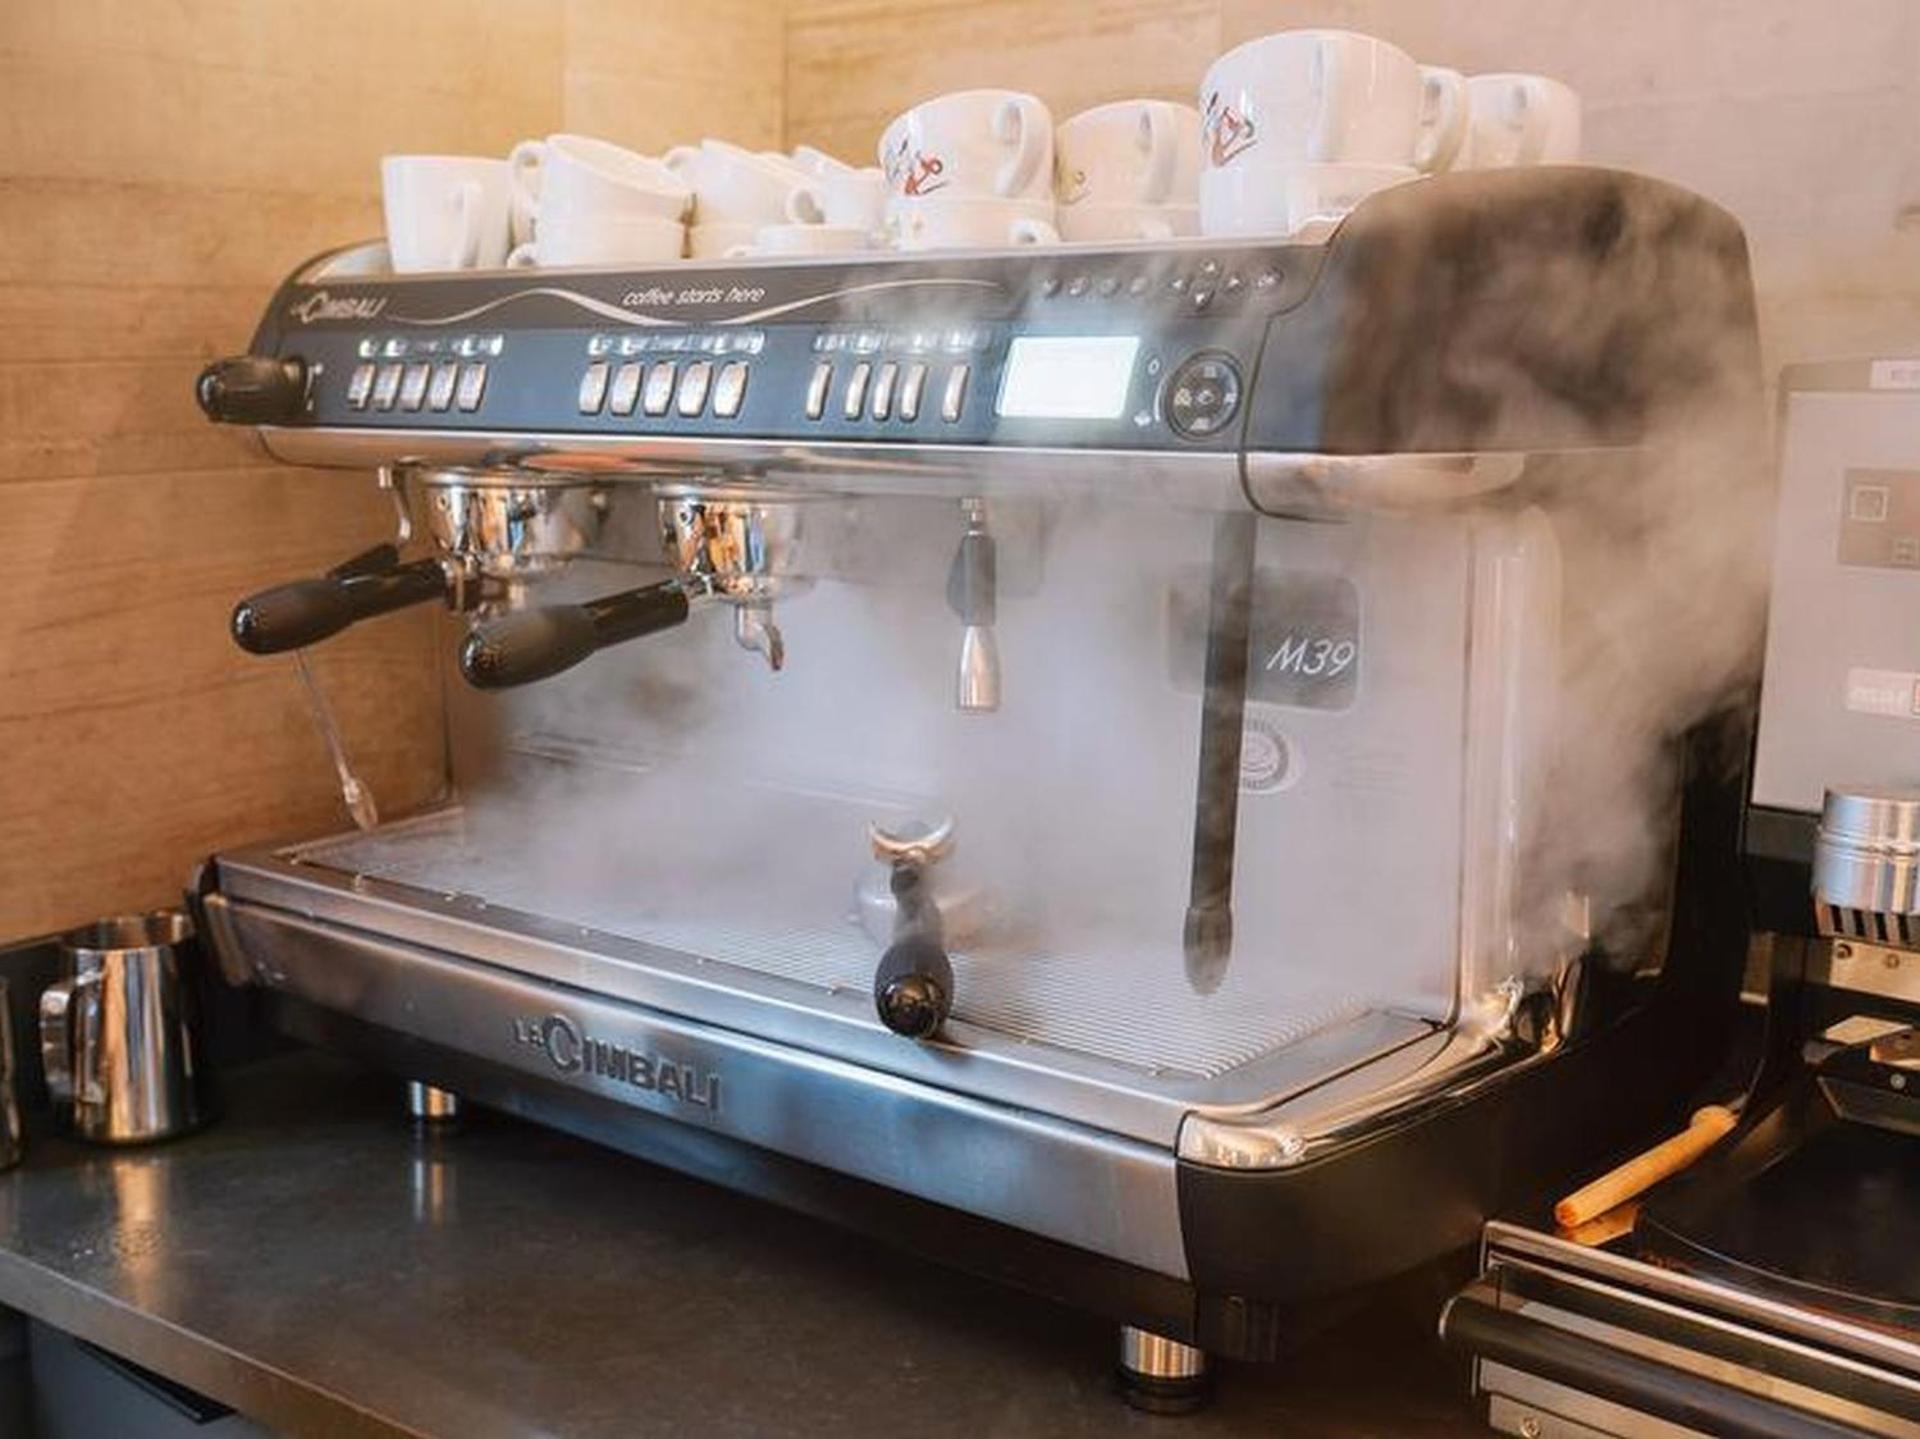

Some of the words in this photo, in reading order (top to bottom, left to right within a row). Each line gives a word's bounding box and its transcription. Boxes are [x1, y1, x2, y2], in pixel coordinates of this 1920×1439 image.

[622, 286, 675, 306] coffee
[676, 286, 725, 305] starts
[724, 285, 766, 303] here
[1265, 636, 1356, 677] M39
[546, 1013, 720, 1113] CIMBALI
